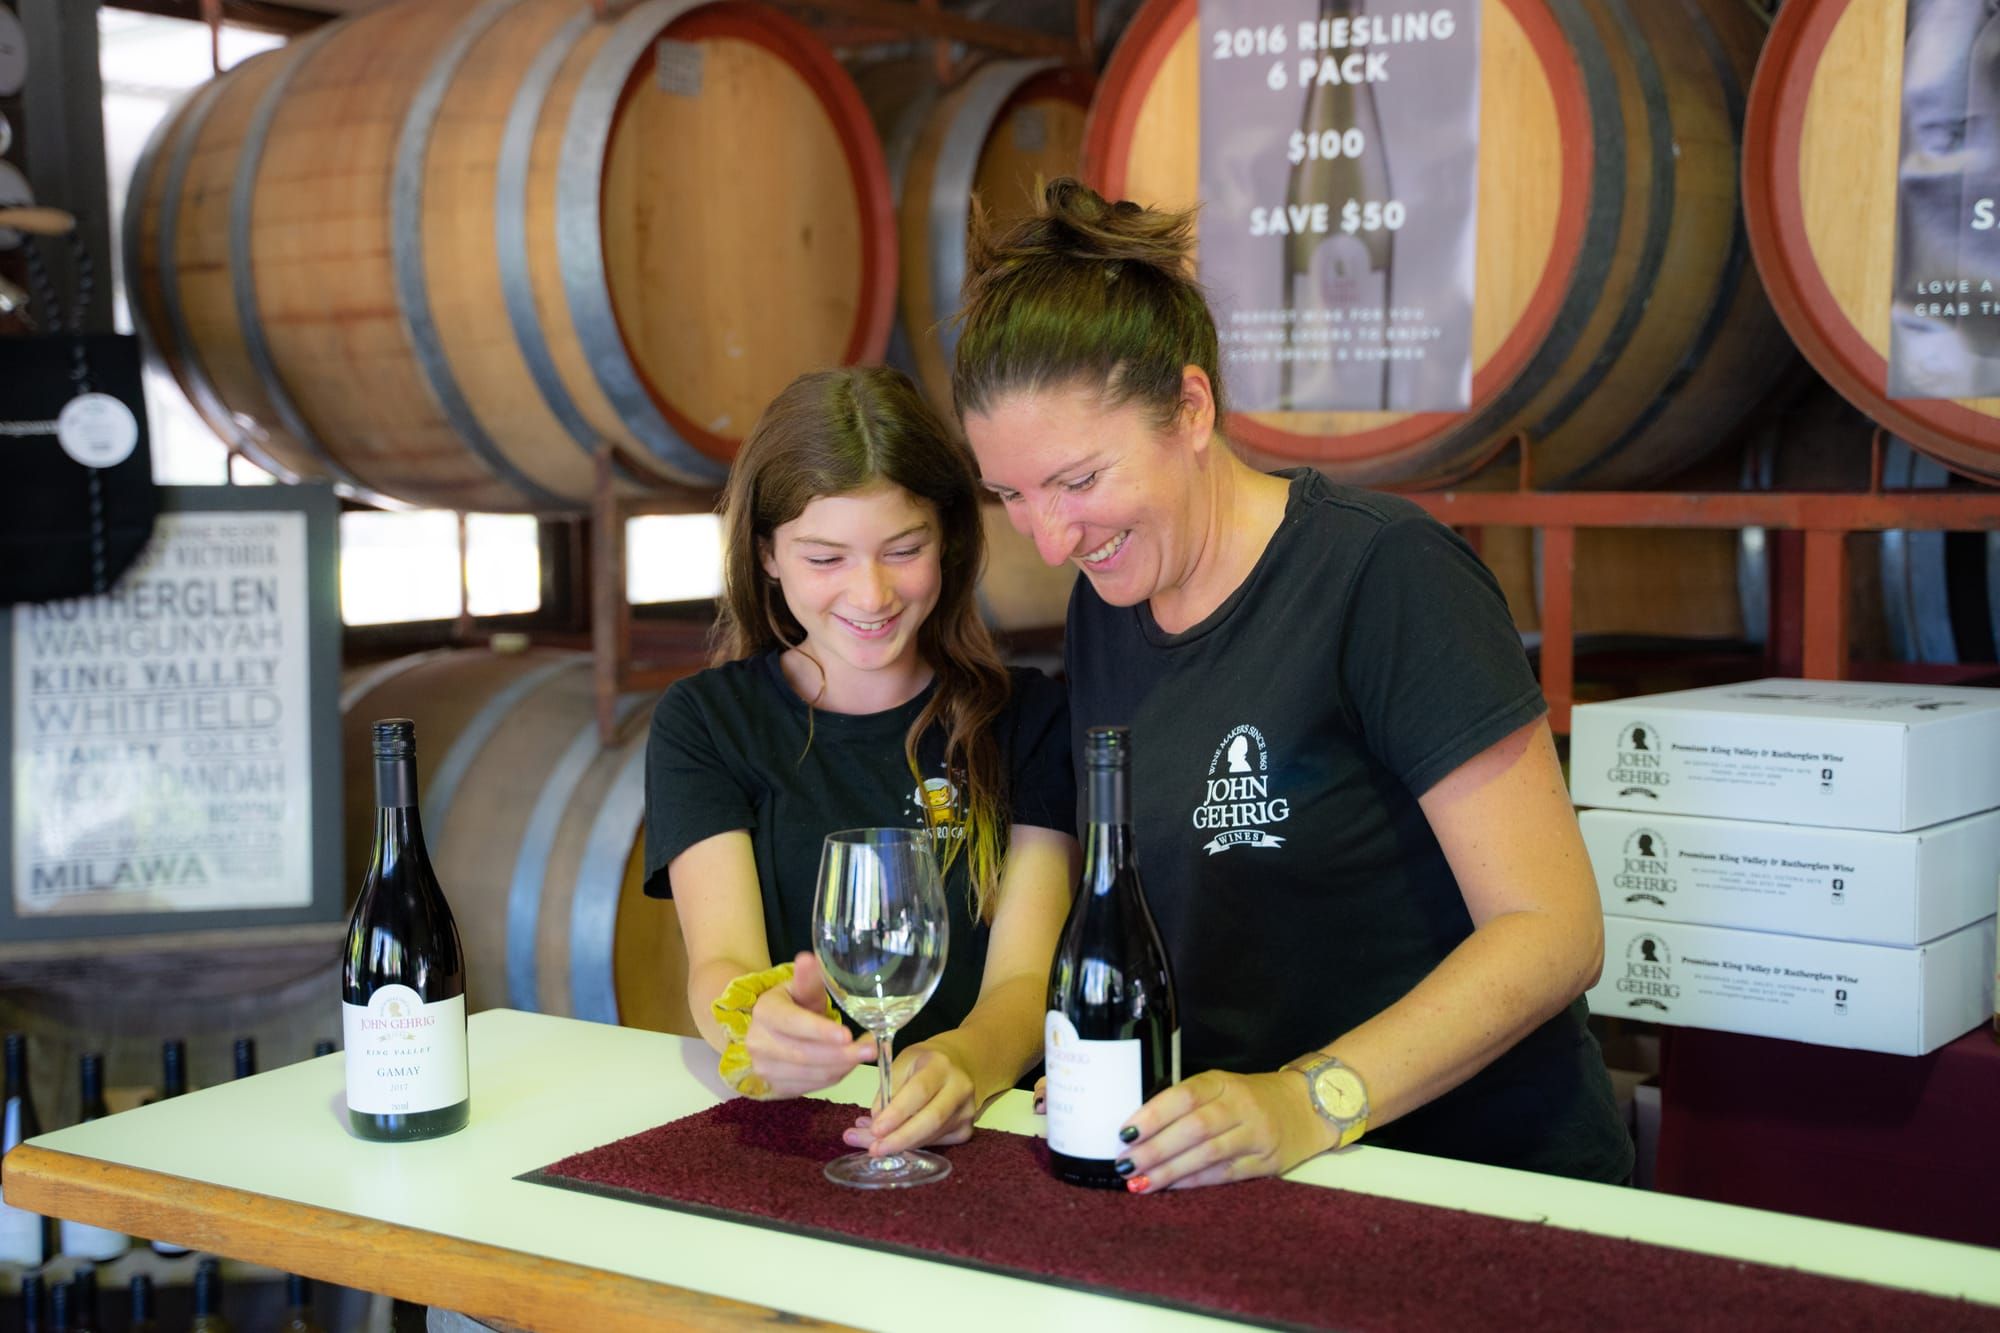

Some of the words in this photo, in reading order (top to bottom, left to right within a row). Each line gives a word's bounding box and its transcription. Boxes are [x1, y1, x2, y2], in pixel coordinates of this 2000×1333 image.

[1213, 25, 1287, 60] 2016
[1298, 10, 1455, 52] RIESLING
[1266, 61, 1288, 90] 6
[1298, 53, 1389, 86] PACK
[1288, 127, 1364, 164] $100
[1249, 205, 1328, 236] SAVE
[1340, 200, 1406, 235] $50
[1971, 198, 2000, 230] S
[1917, 281, 1969, 295] LOVE
[1980, 280, 1993, 292] A
[1349, 306, 1384, 322] FOR
[1914, 303, 1970, 317] GRAB
[1358, 327, 1381, 341] TO
[30, 621, 285, 659] WAHGUNYAH
[31, 663, 128, 690] KING
[140, 658, 280, 686] VALLEY
[30, 693, 284, 732] WHITFIELD
[1208, 748, 1222, 776] WINE
[1219, 724, 1250, 750] MAKERS
[1248, 725, 1266, 751] SINCE
[1671, 743, 1708, 752] Premium
[1711, 745, 1731, 756] King
[1734, 746, 1758, 757] Valley
[1771, 750, 1819, 762] Rutherglen
[1822, 753, 1843, 762] Wine
[1616, 752, 1661, 769] JOHN
[1607, 768, 1671, 786] GEHRIG
[1203, 775, 1269, 806] JOHN
[1192, 798, 1290, 829] GEHRIG
[922, 825, 948, 840] SRO
[951, 825, 967, 840] CA
[1218, 832, 1259, 845] WINES
[1623, 858, 1669, 874] JOHN
[1678, 850, 1716, 860] Premium
[1719, 853, 1739, 864] King
[1742, 856, 1767, 867] Valley
[1781, 859, 1830, 872] Rutherglen
[1833, 863, 1855, 873] Wine
[32, 855, 209, 891] MILAWA
[1613, 874, 1678, 893] GEHRIG
[1625, 962, 1671, 980] JOHN
[1681, 956, 1719, 967] Premium
[1722, 961, 1742, 972] King
[1746, 964, 1770, 974] Valley
[1784, 969, 1833, 981] Rutherglen
[1836, 974, 1858, 984] Wine
[1616, 978, 1681, 999] GEHRIG
[361, 1018, 387, 1031] JOHN
[390, 1016, 435, 1029] GEHRIG
[366, 1048, 389, 1056] KING
[394, 1046, 431, 1056] VALLEY
[377, 1065, 420, 1078] GAMAY
